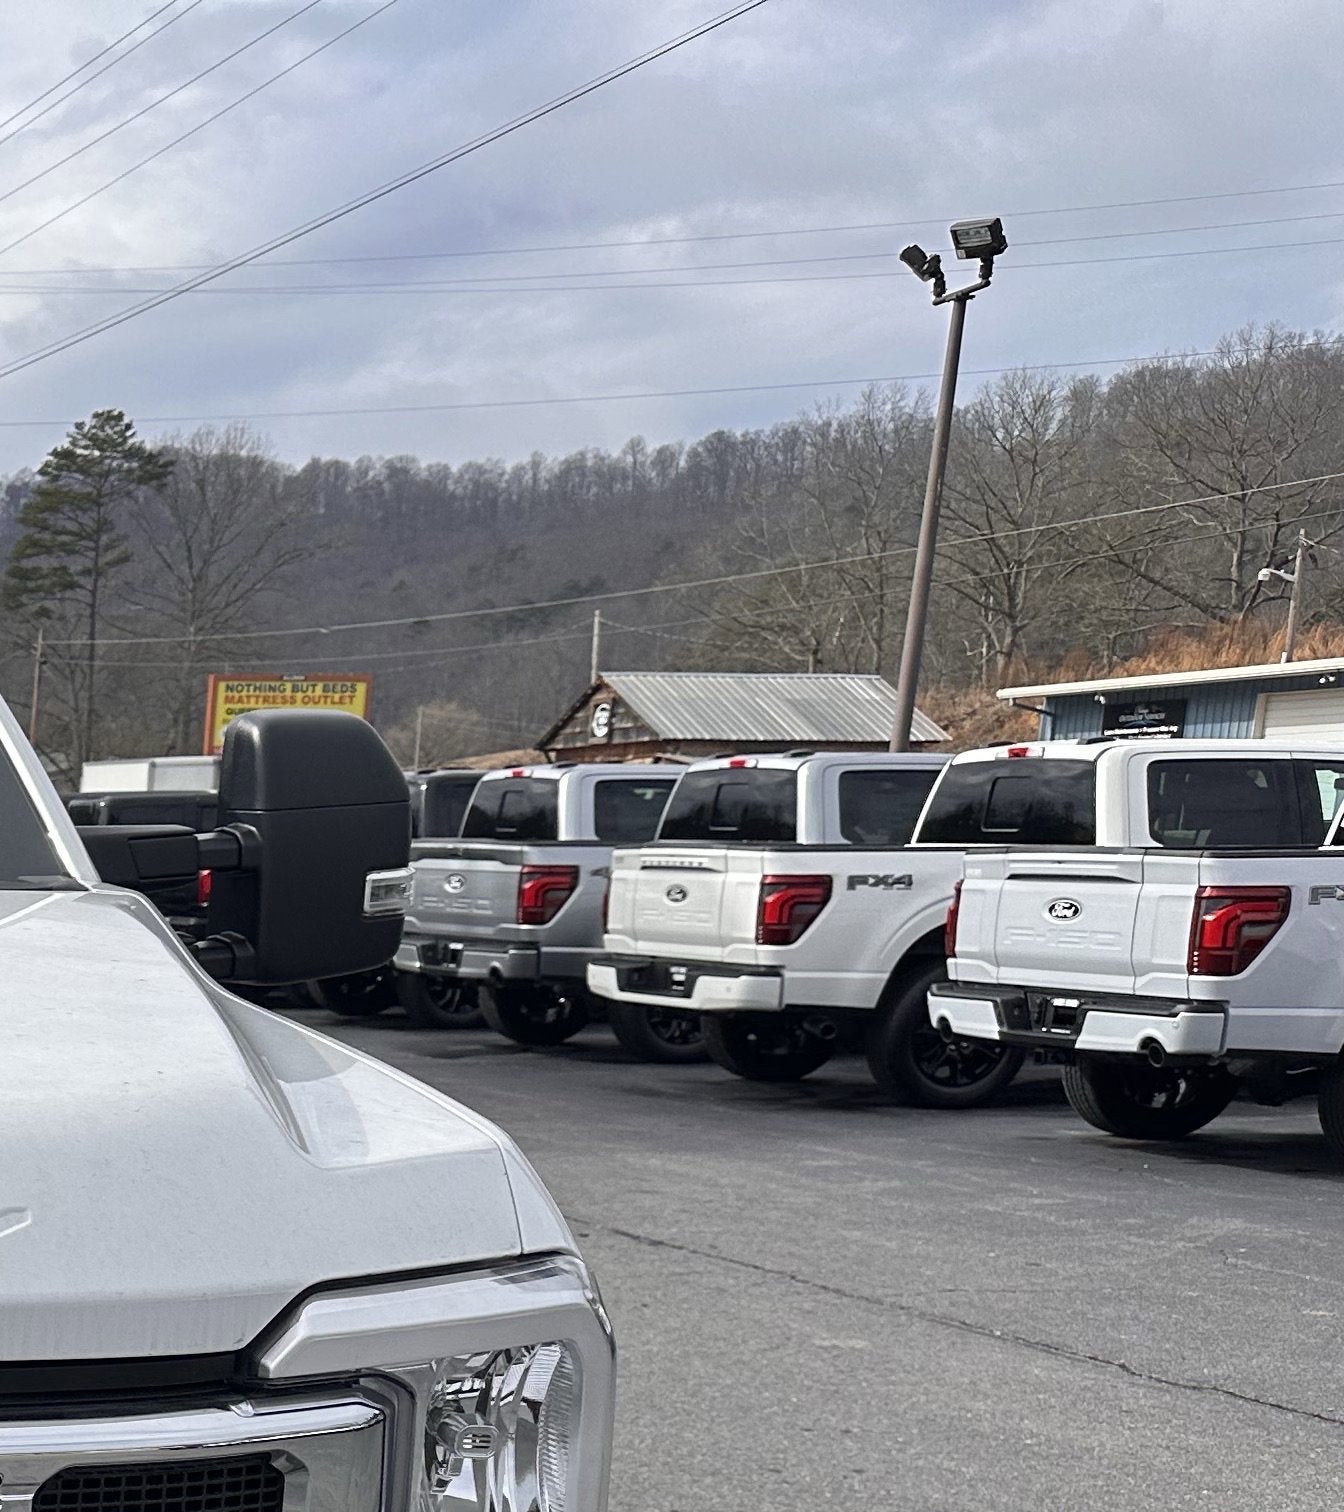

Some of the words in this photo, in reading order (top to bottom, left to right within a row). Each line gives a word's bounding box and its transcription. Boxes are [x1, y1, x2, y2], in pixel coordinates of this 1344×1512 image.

[224, 683, 287, 693] NOTHING
[290, 683, 318, 693] BUT
[322, 683, 358, 693] BEDS
[224, 694, 297, 705] MATTRESS
[301, 694, 356, 705] OUTLET
[846, 874, 914, 891] FX4
